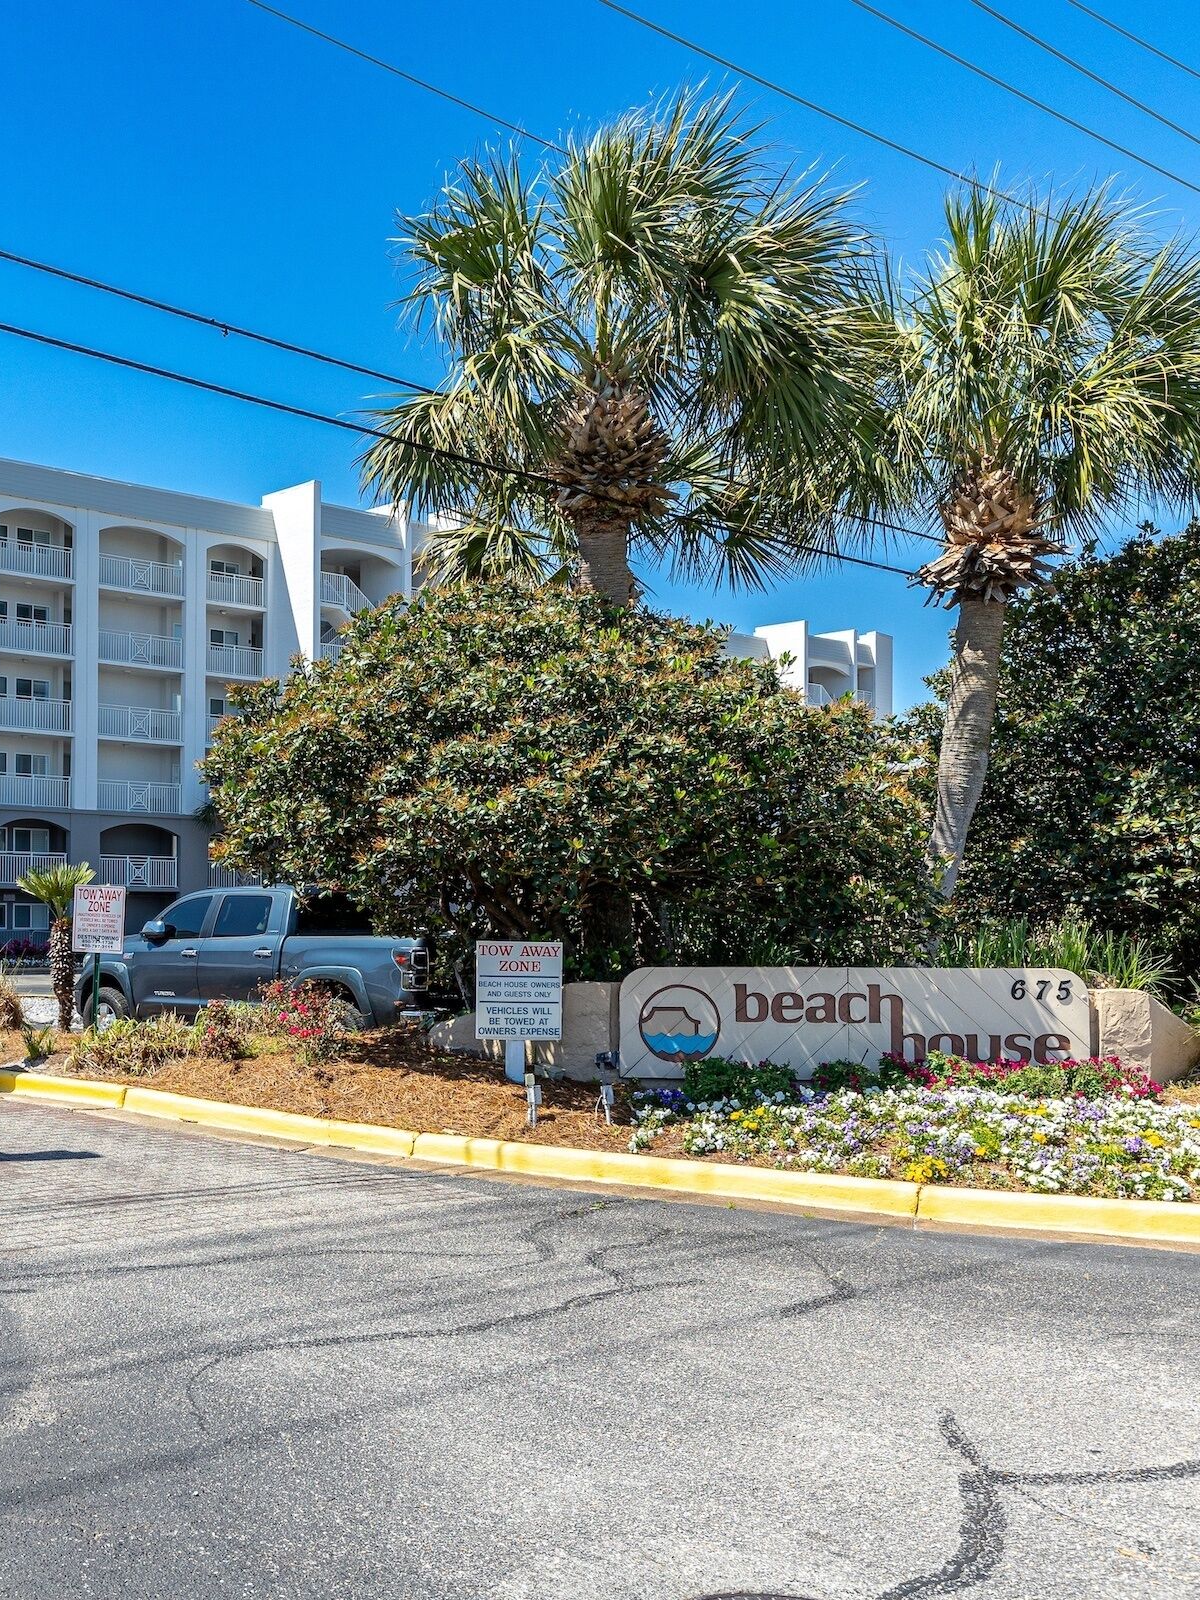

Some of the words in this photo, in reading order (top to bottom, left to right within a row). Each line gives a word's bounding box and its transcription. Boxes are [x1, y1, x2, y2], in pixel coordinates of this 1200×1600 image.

[78, 888, 96, 900] TOW
[99, 889, 122, 901] AWAY
[87, 901, 111, 912] ZONE
[479, 945, 513, 956] TOW
[520, 945, 561, 957] AWAY
[499, 960, 541, 972] ZONE
[478, 980, 502, 988] BEACH
[530, 981, 560, 989] OWNERS
[1010, 979, 1073, 1001] 675
[486, 1006, 529, 1015] VEHICLES
[532, 1007, 552, 1015] WILL
[733, 983, 903, 1047] beach
[489, 1017, 500, 1025] BE
[504, 1017, 535, 1025] TOWED
[538, 1018, 549, 1026] AT
[478, 1027, 517, 1035] OWNERS
[520, 1027, 560, 1036] EXPENSE
[892, 1031, 1072, 1065] house
